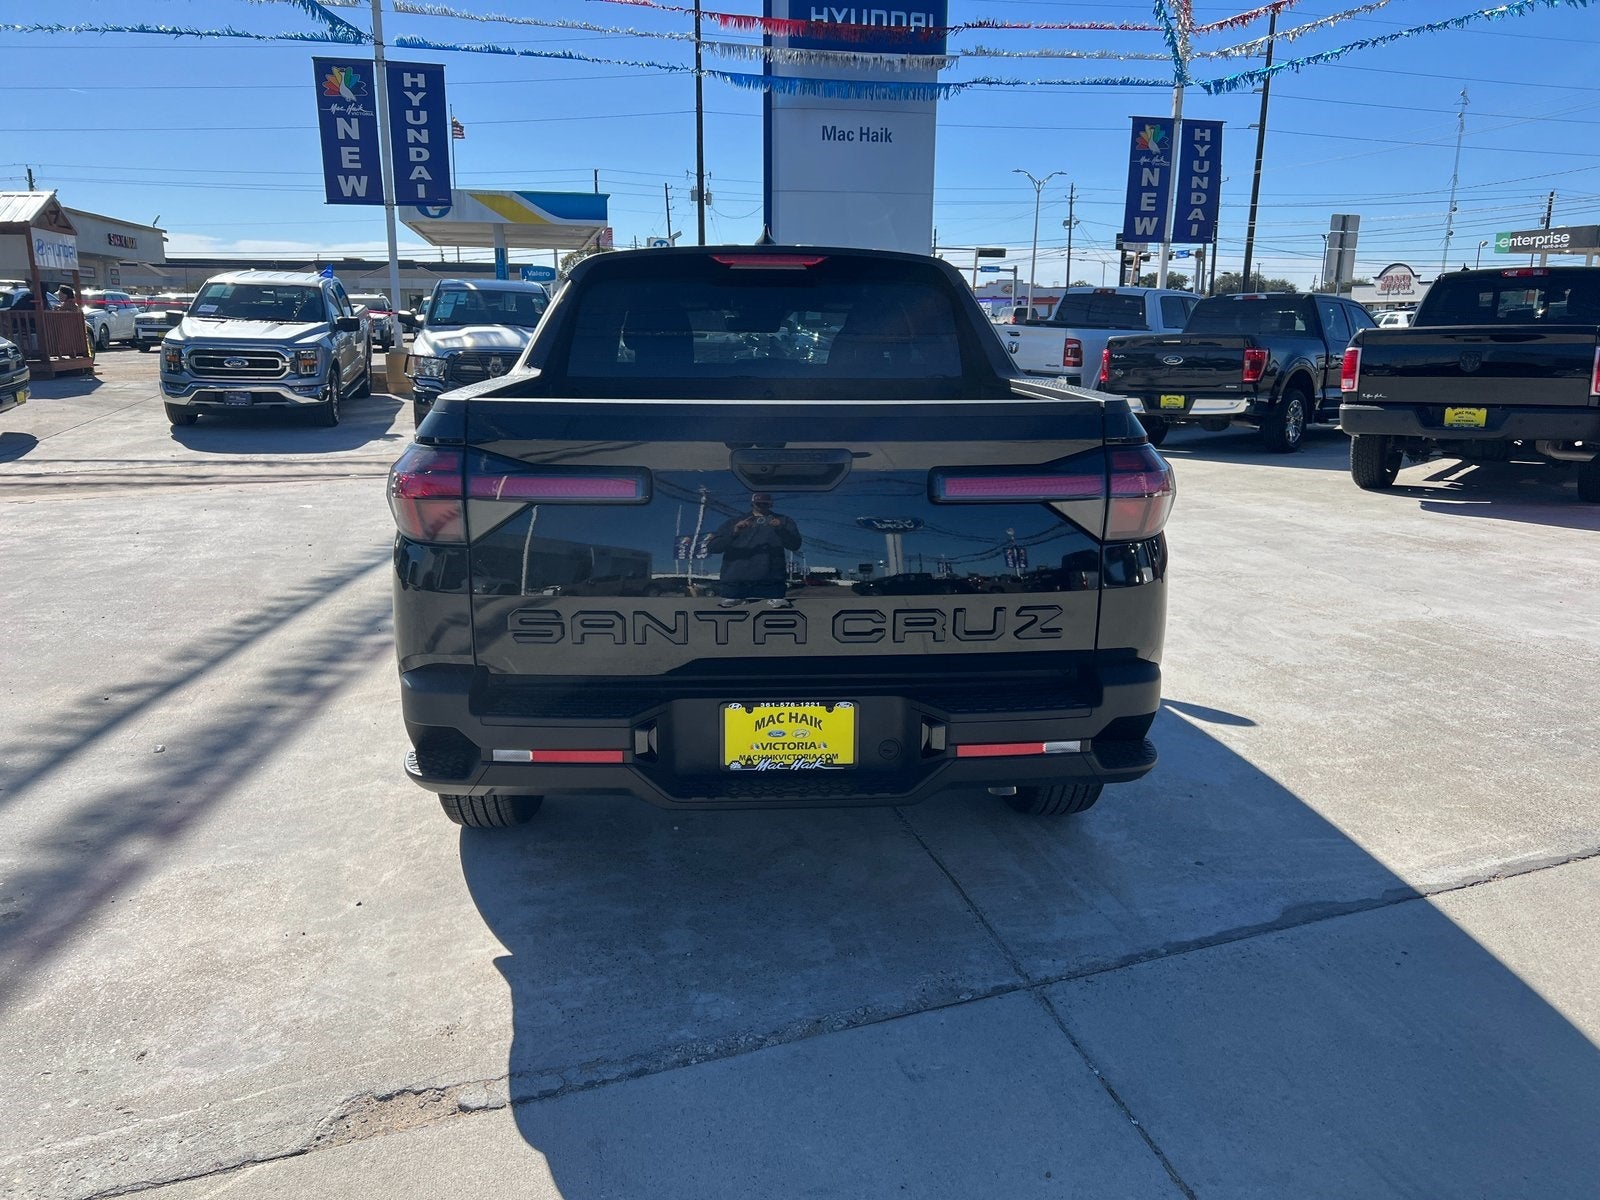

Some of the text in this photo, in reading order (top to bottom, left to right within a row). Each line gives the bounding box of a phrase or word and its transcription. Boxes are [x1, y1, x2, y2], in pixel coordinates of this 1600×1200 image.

[402, 73, 433, 199] HYUNDAI
[821, 125, 893, 143] Mac Haik
[336, 117, 368, 197] NEW
[1188, 128, 1211, 236] HYUNDAI
[1134, 168, 1160, 236] NEW
[1498, 231, 1570, 249] enterprise
[507, 604, 1064, 646] SANTA CRUZ
[754, 712, 823, 732] MAC HAIK
[760, 741, 817, 751] VICTORIA
[755, 758, 823, 771] Mac Haik
